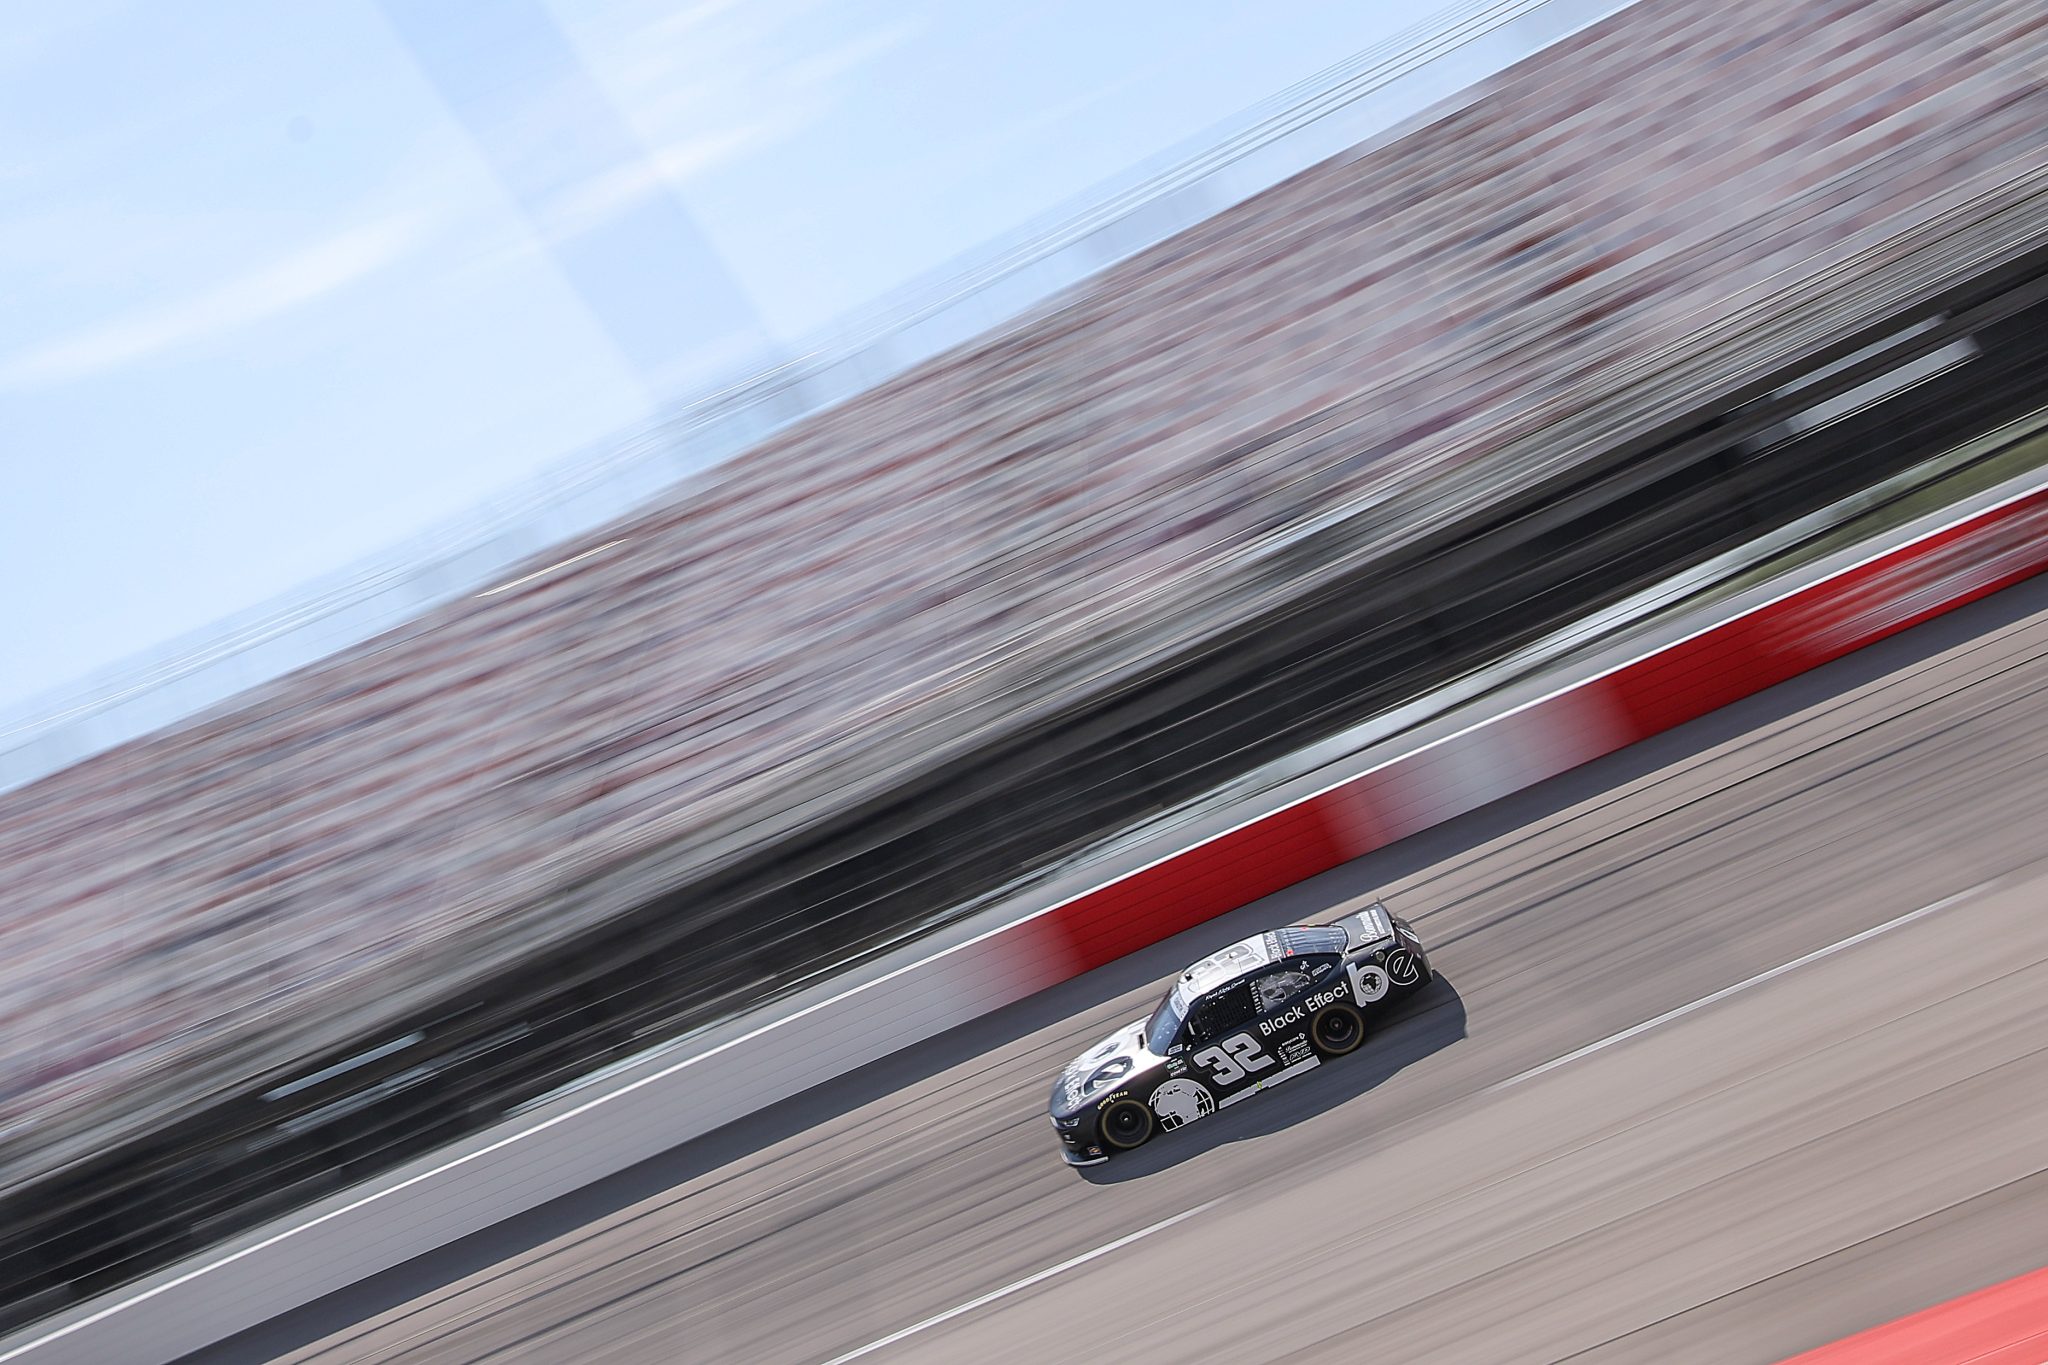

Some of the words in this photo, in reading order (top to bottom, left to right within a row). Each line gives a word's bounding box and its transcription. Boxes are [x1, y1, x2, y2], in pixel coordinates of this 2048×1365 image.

[1259, 1007, 1305, 1036] Black
[1305, 981, 1349, 1012] Effect
[1193, 1032, 1275, 1086] 32
[1097, 1091, 1129, 1110] GOODYEAR
